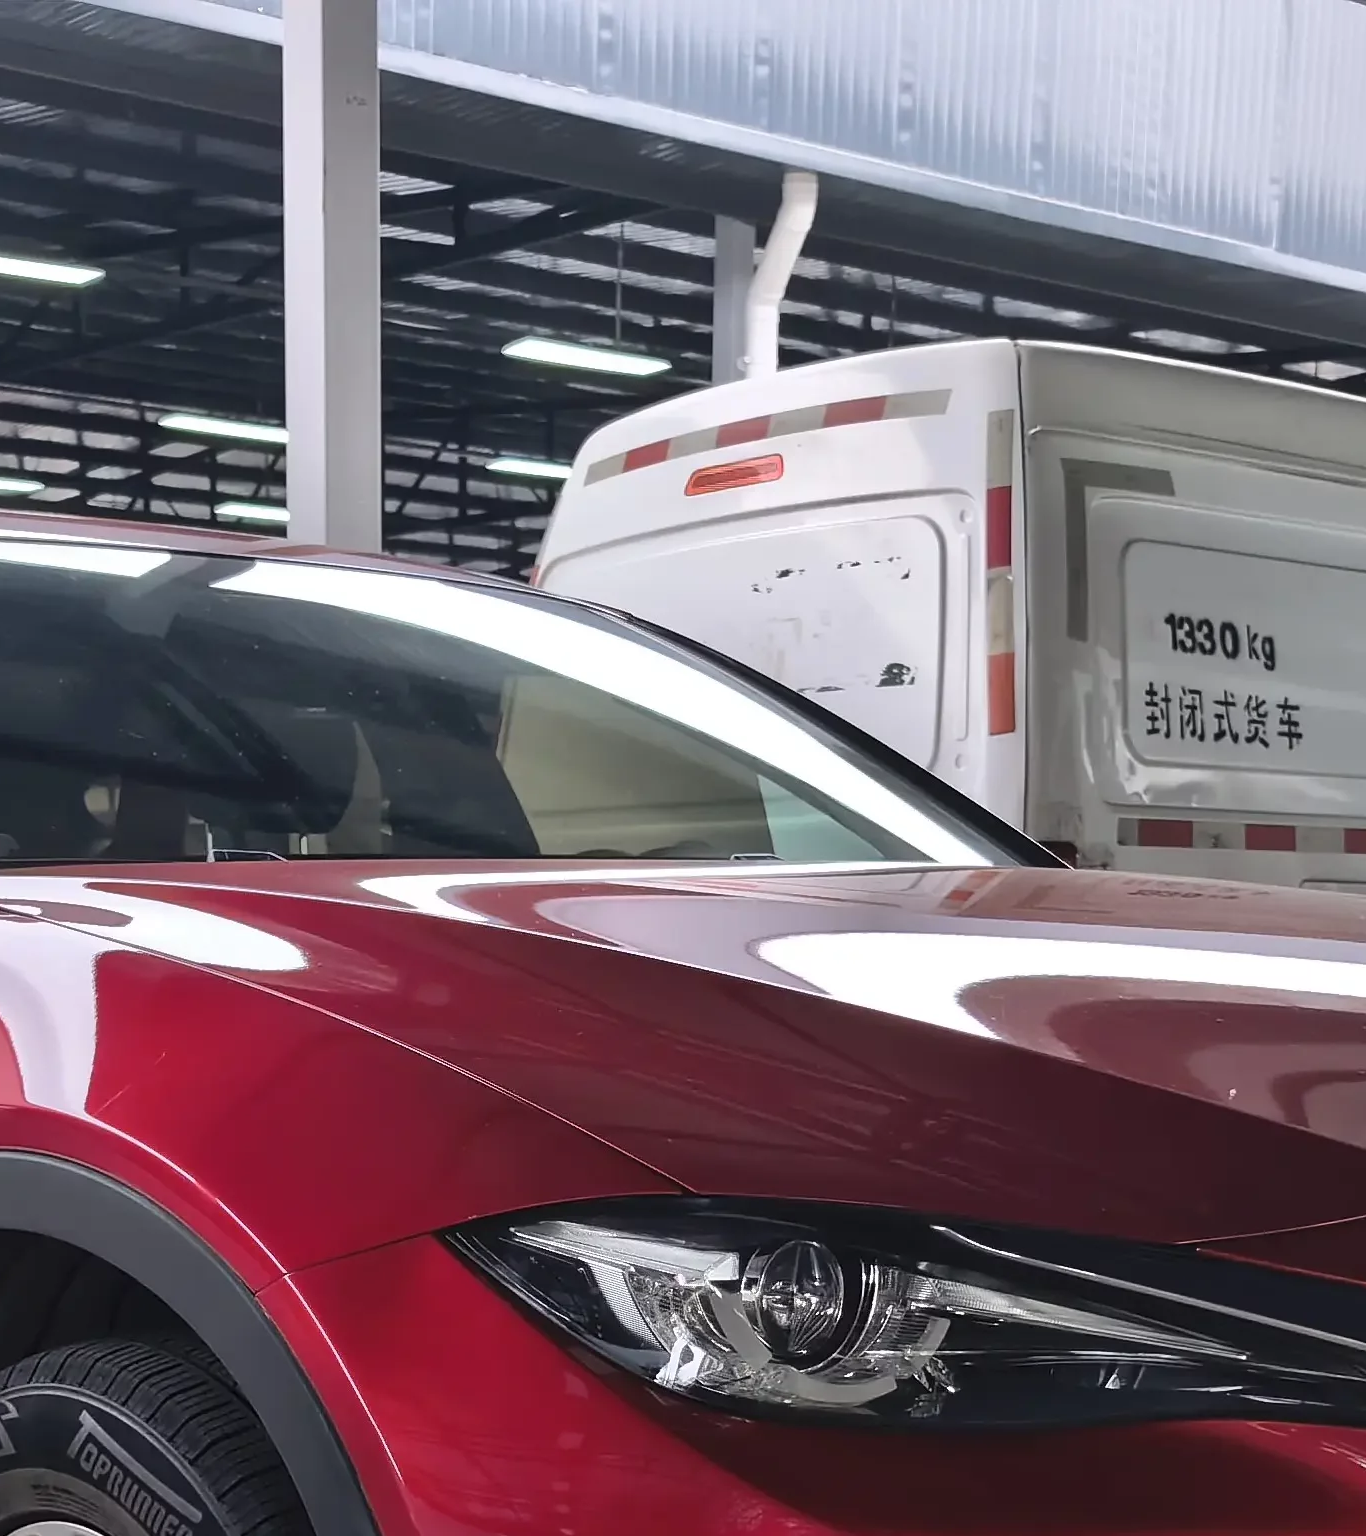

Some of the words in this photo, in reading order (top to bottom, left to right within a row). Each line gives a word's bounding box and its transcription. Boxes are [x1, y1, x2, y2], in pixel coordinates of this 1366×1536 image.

[1163, 612, 1241, 660] 1330
[1245, 624, 1276, 671] kg
[1144, 681, 1304, 750] 封闭式货车
